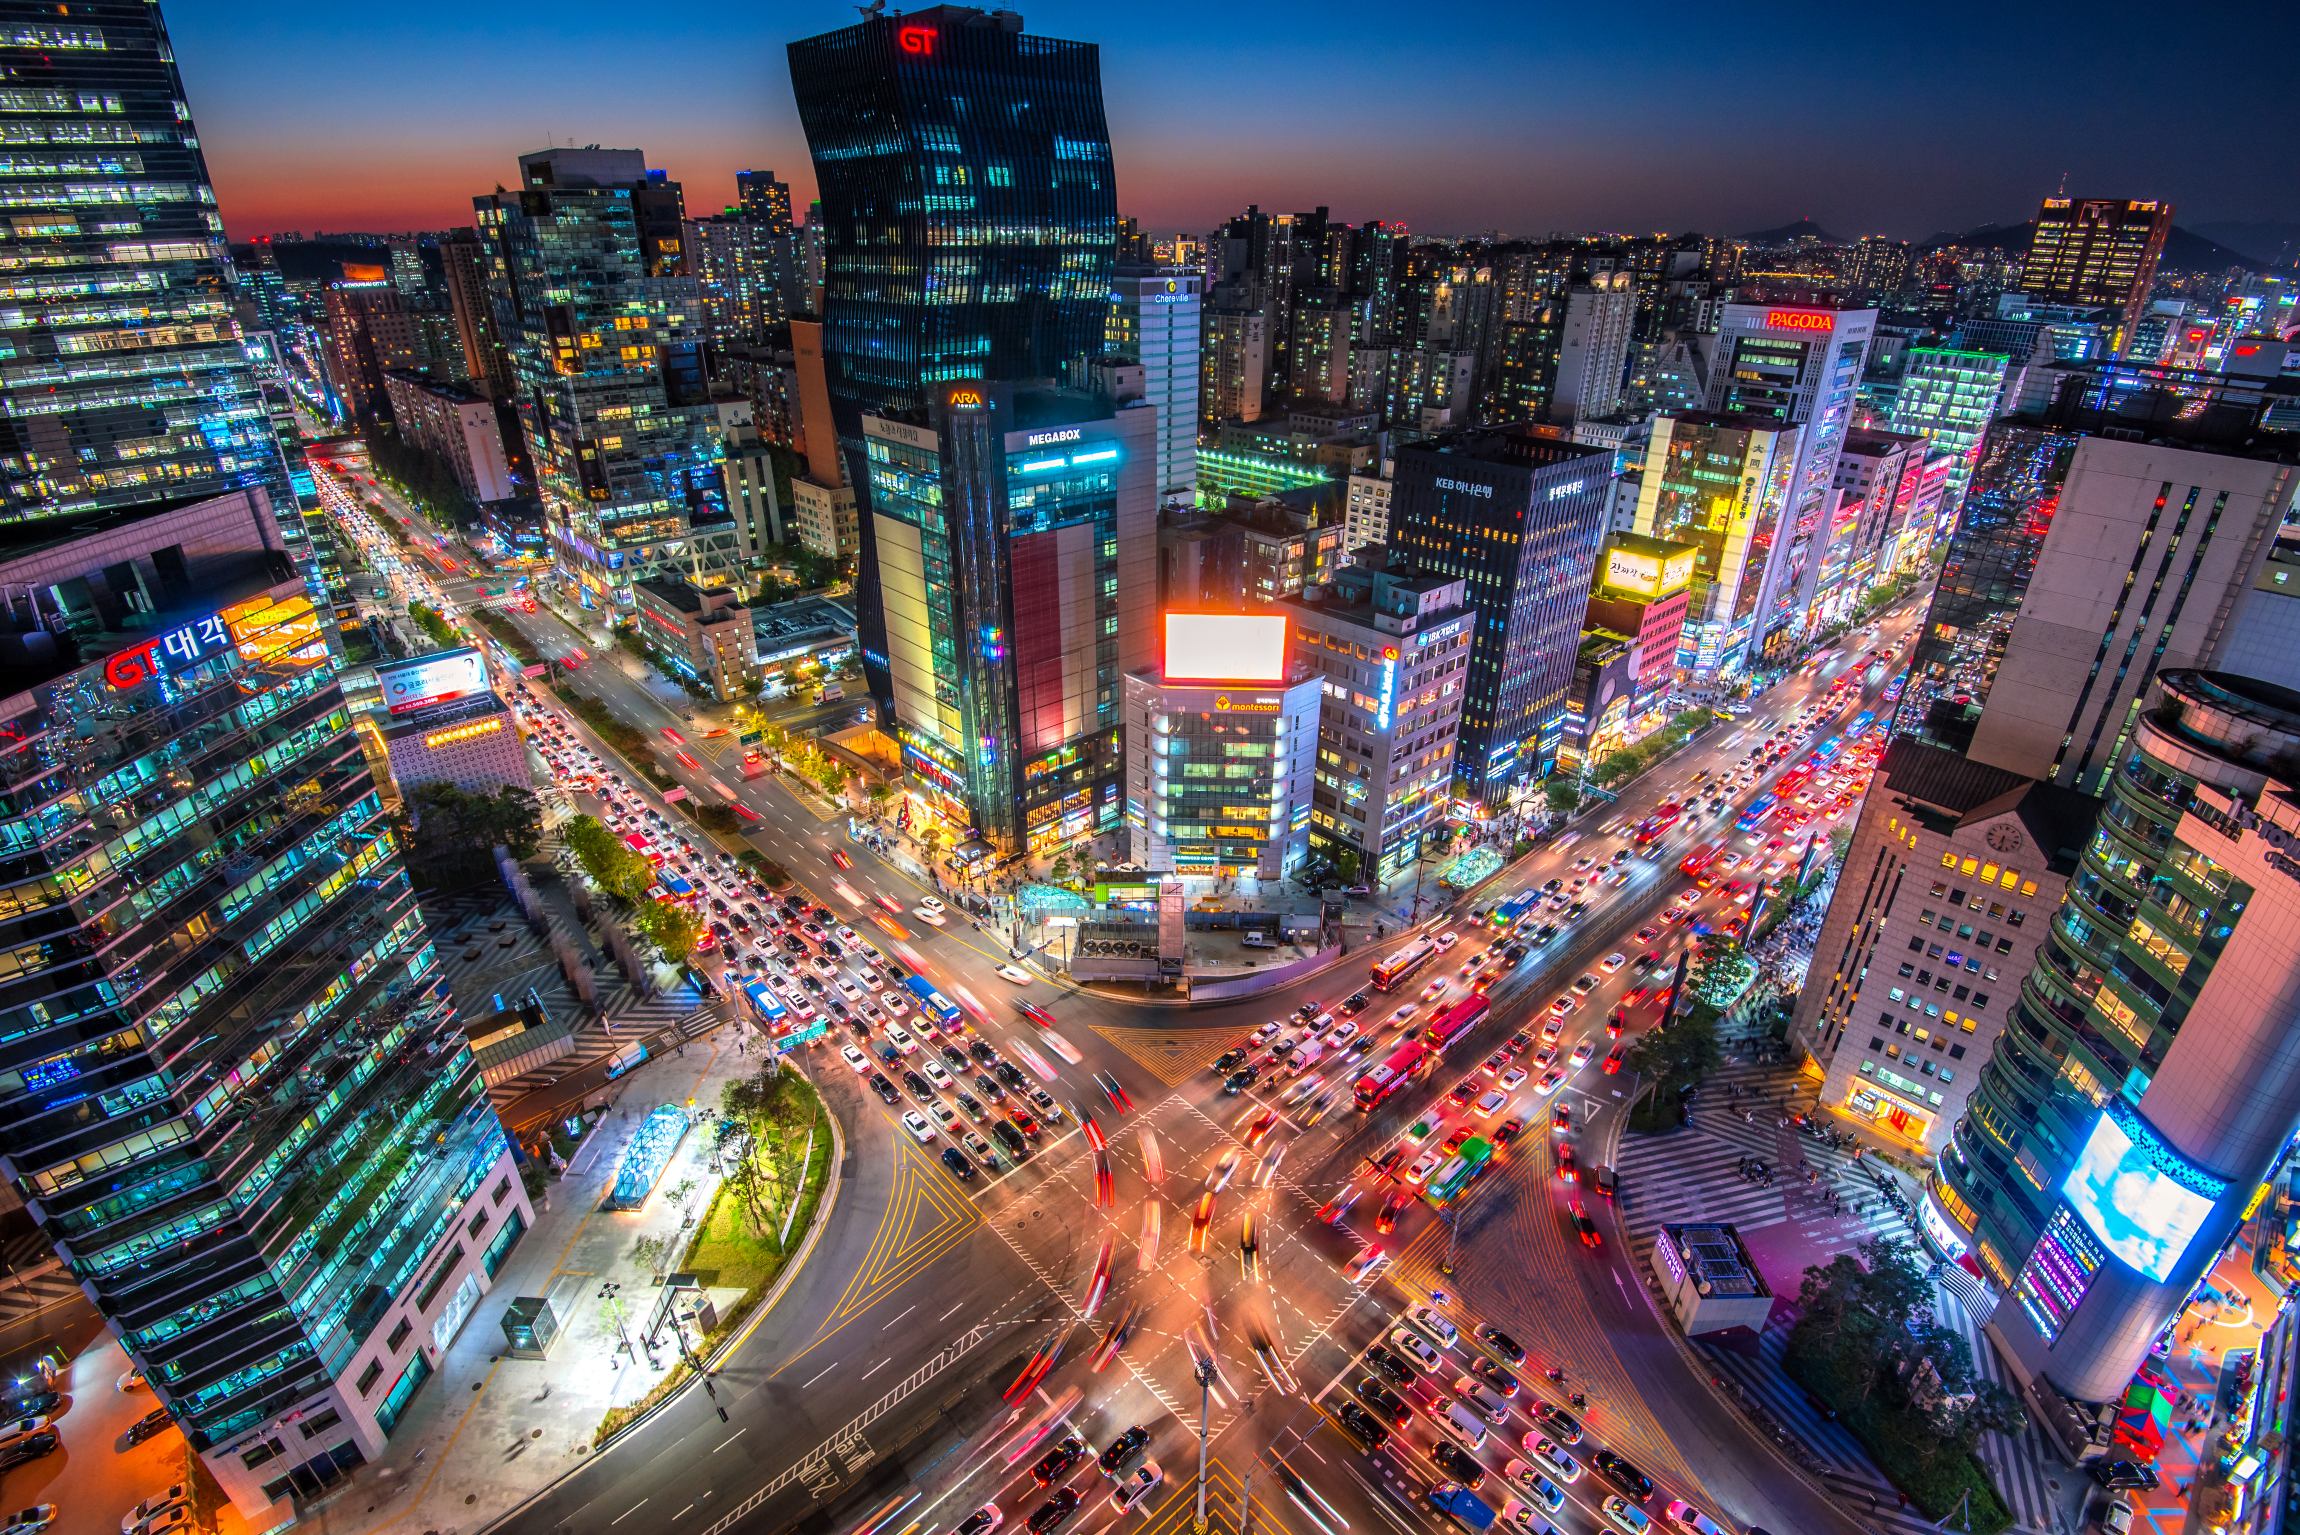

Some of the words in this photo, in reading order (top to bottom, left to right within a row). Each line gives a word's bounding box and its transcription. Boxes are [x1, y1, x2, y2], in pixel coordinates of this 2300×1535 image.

[900, 27, 938, 55] GT
[1155, 293, 1189, 303] Chereville
[1768, 312, 1832, 330] PAGODA
[951, 393, 980, 404] ARA
[1029, 428, 1080, 446] MEGABOX
[1436, 477, 1454, 490] KEB
[1456, 482, 1493, 499] 하나은행
[164, 616, 227, 660] 대각
[1896, 1100, 1920, 1115] COFFEE
